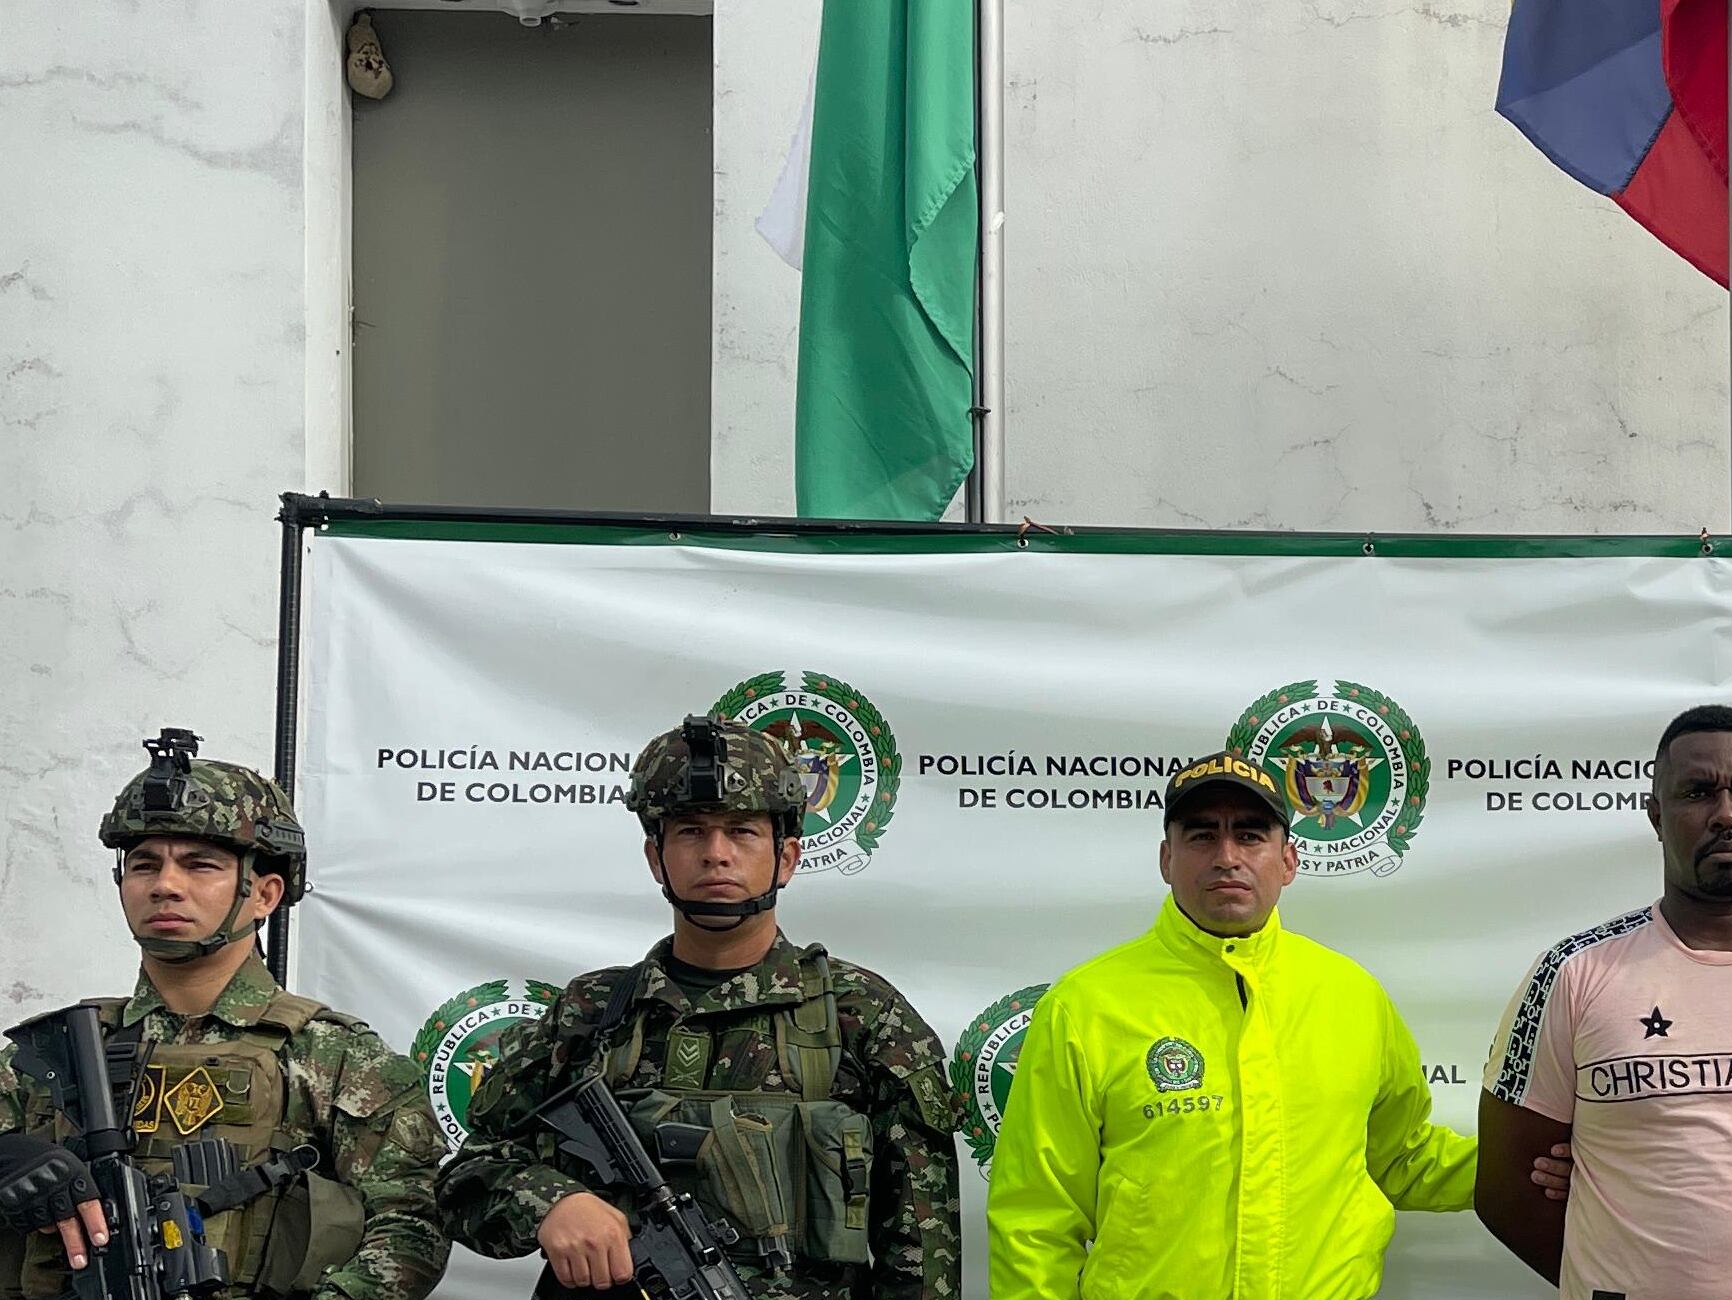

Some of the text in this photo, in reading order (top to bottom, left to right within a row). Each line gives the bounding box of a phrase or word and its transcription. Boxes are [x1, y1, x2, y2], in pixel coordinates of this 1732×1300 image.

[785, 694, 807, 706] DE
[825, 704, 875, 786] COLOMBIA
[1317, 700, 1404, 790] DE COLOMBIA
[377, 744, 499, 770] POLICÍA
[919, 749, 1194, 777] POLICÍA NACIONA
[1447, 754, 1559, 780] POLICÍA
[1175, 756, 1276, 793] POLICIA
[417, 782, 628, 805] DE COLOMBIA
[959, 788, 1165, 810] DE COLOMBIA
[1486, 792, 1523, 811] DE
[1327, 808, 1398, 853] NACIONAL
[1327, 850, 1379, 872] PATRIA
[508, 1003, 530, 1015] DE
[1143, 1095, 1223, 1119] 614597
